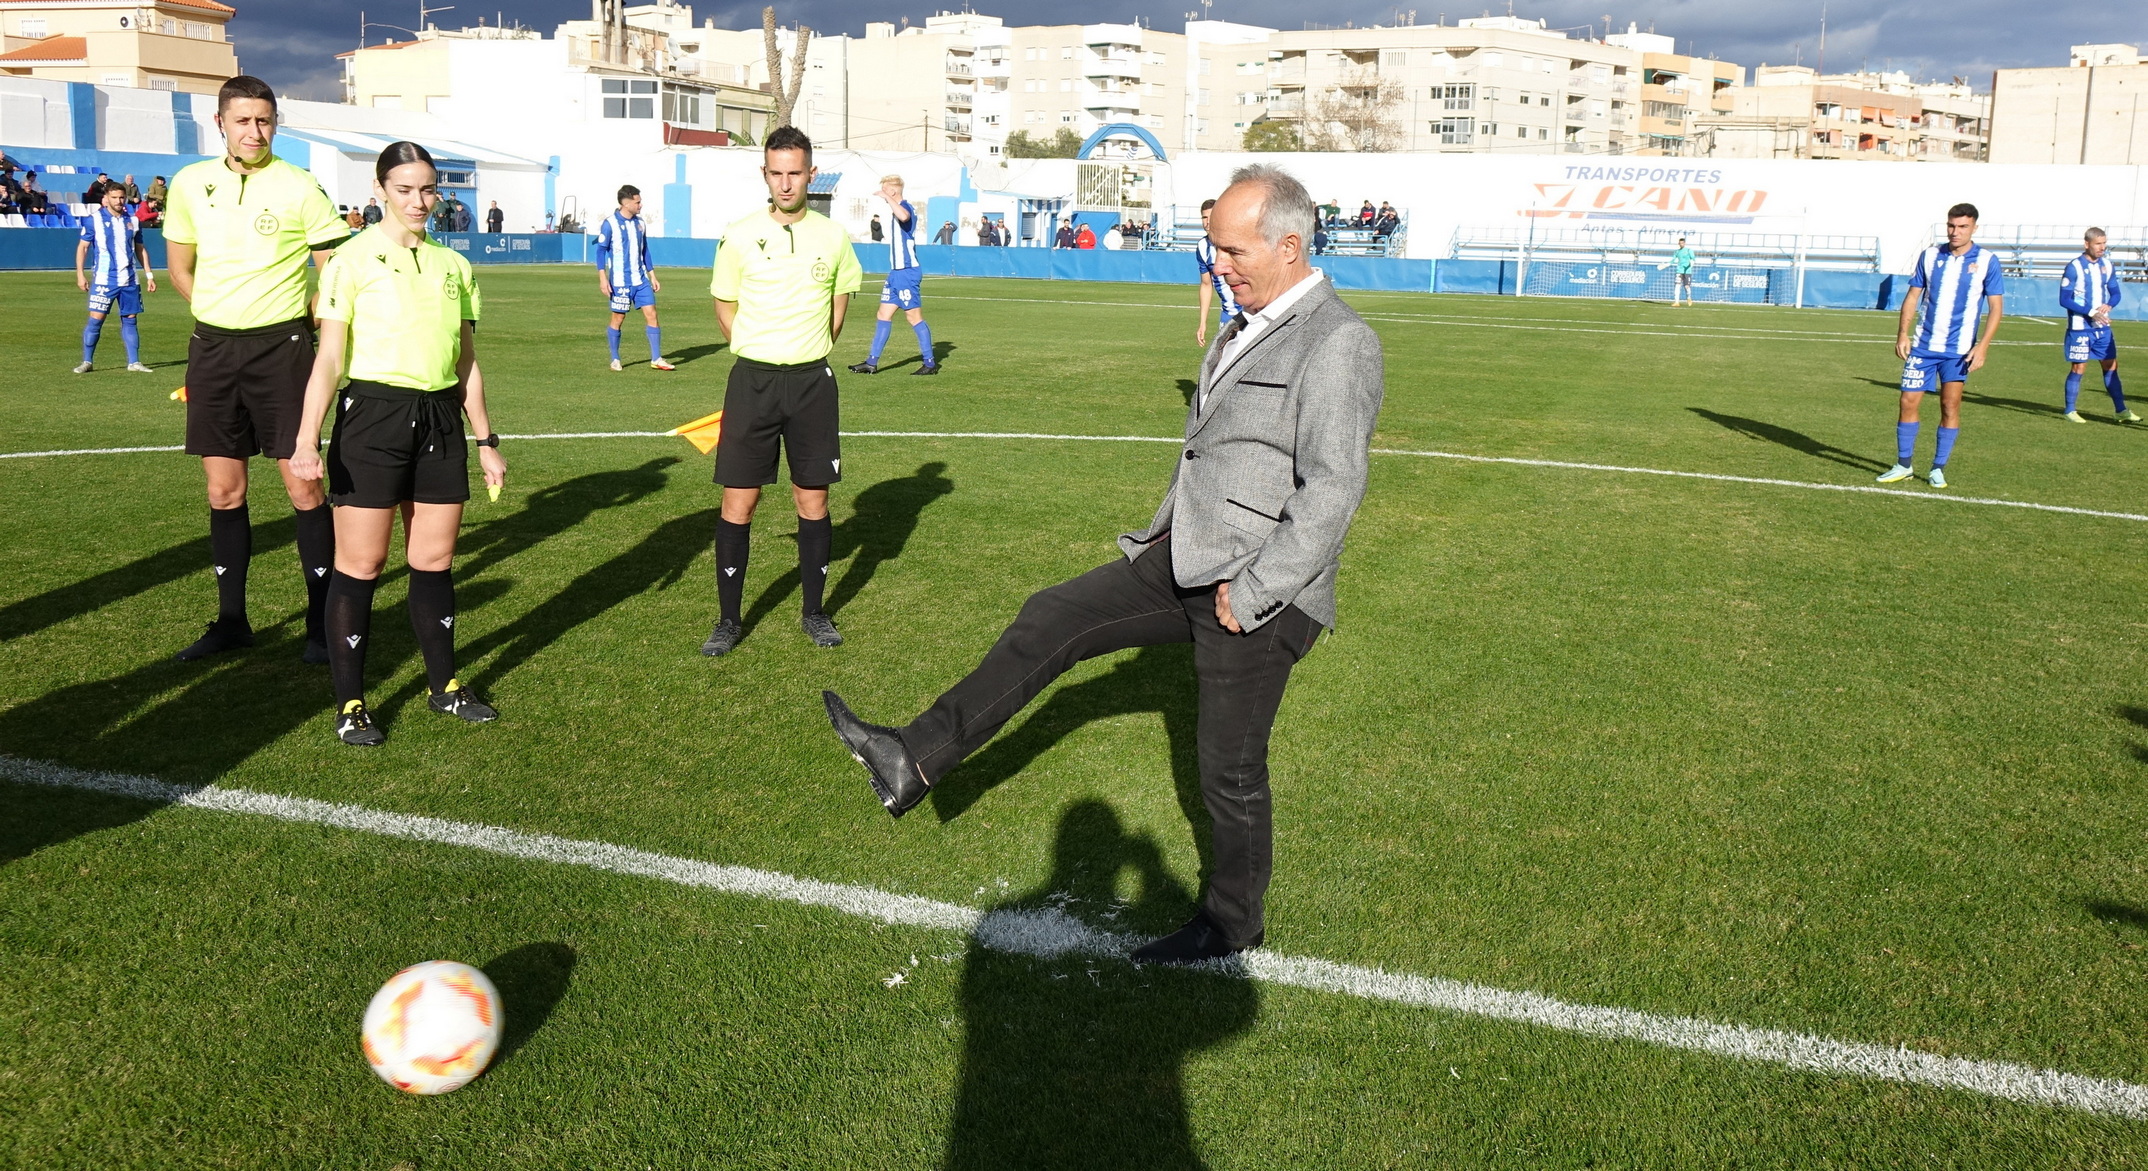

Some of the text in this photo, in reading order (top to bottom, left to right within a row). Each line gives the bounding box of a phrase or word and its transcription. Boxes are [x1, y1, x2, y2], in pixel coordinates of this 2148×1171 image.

[1564, 166, 1722, 184] TRANSPORTES
[1592, 185, 1769, 213] CANO
[1581, 223, 1625, 234] Antas
[898, 288, 912, 302] 48
